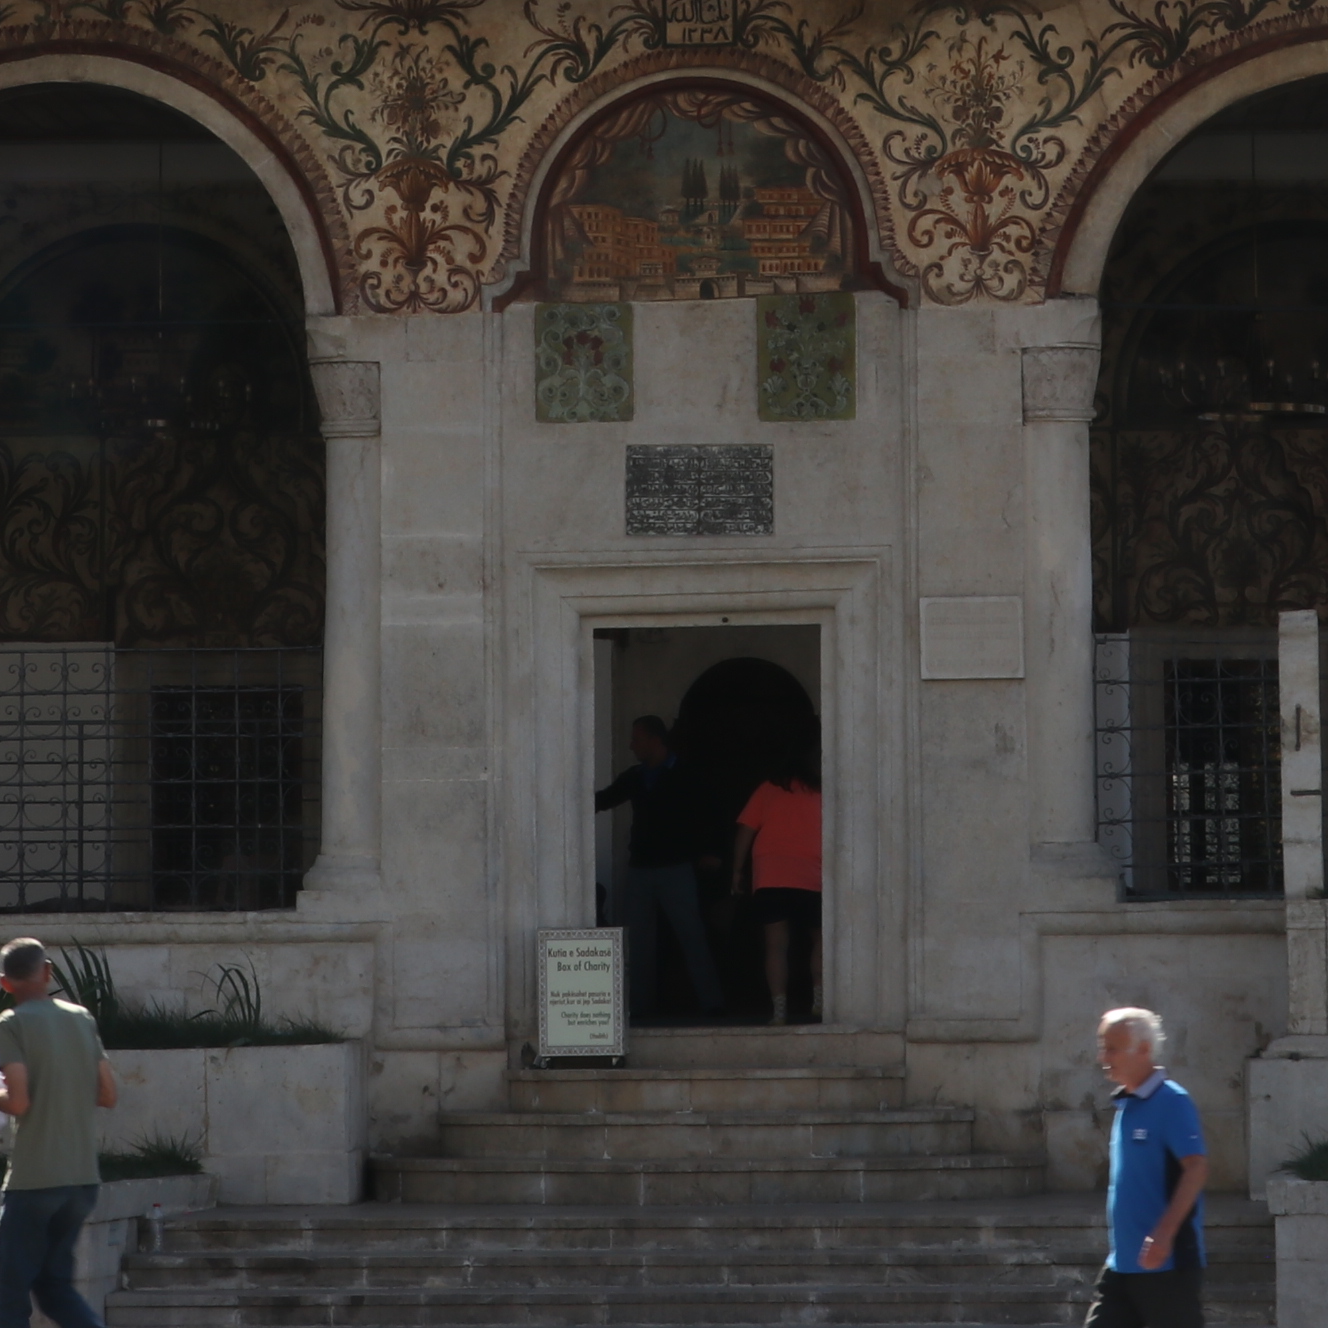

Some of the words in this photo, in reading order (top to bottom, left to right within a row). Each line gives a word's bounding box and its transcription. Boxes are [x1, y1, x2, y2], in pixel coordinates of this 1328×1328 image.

[548, 948, 566, 957] Kutia
[576, 947, 611, 957] Sadakasë
[557, 962, 571, 971] Box
[574, 960, 581, 971] of
[584, 961, 610, 972] Charity
